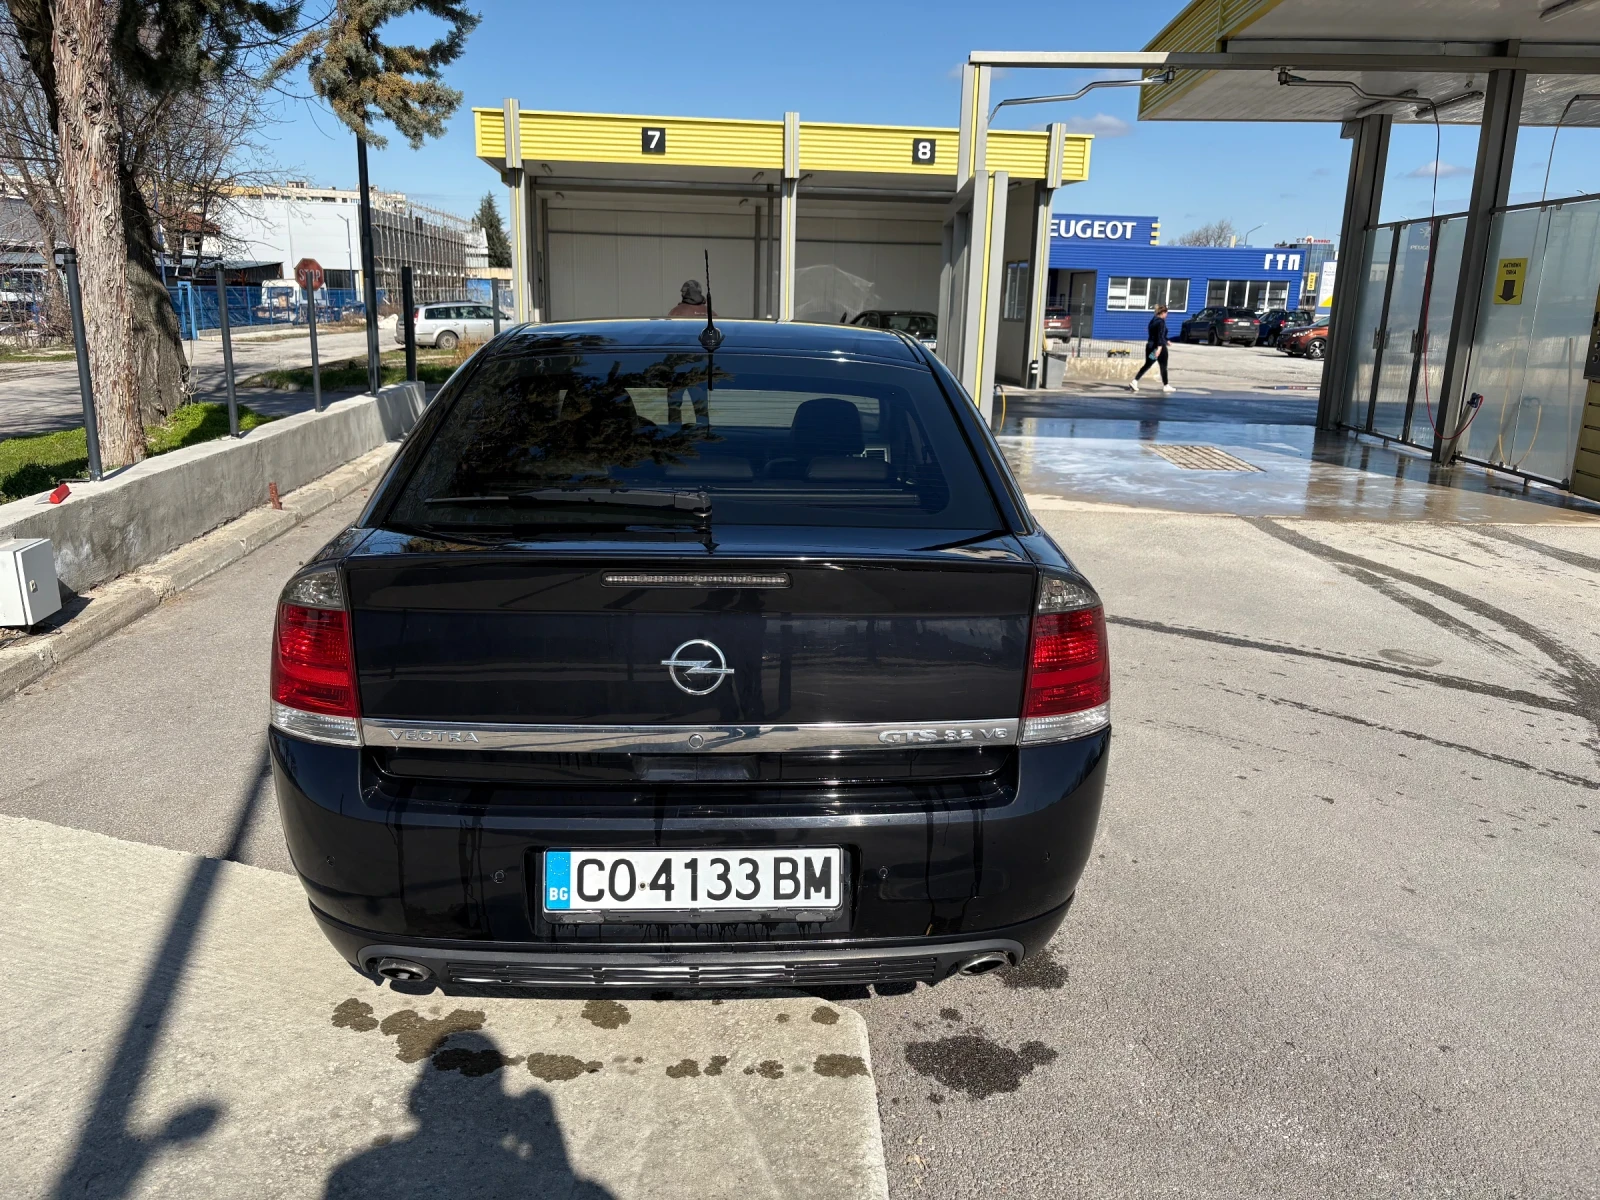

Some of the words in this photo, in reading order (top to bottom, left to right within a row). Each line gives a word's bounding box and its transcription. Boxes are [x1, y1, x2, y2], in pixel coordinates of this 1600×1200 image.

[647, 130, 661, 149] 7
[918, 141, 931, 159] 8
[388, 728, 479, 743] VECTRA
[879, 728, 938, 744] GTS
[979, 727, 1008, 739] V6
[649, 857, 761, 902] 4133
[549, 887, 569, 901] BG
